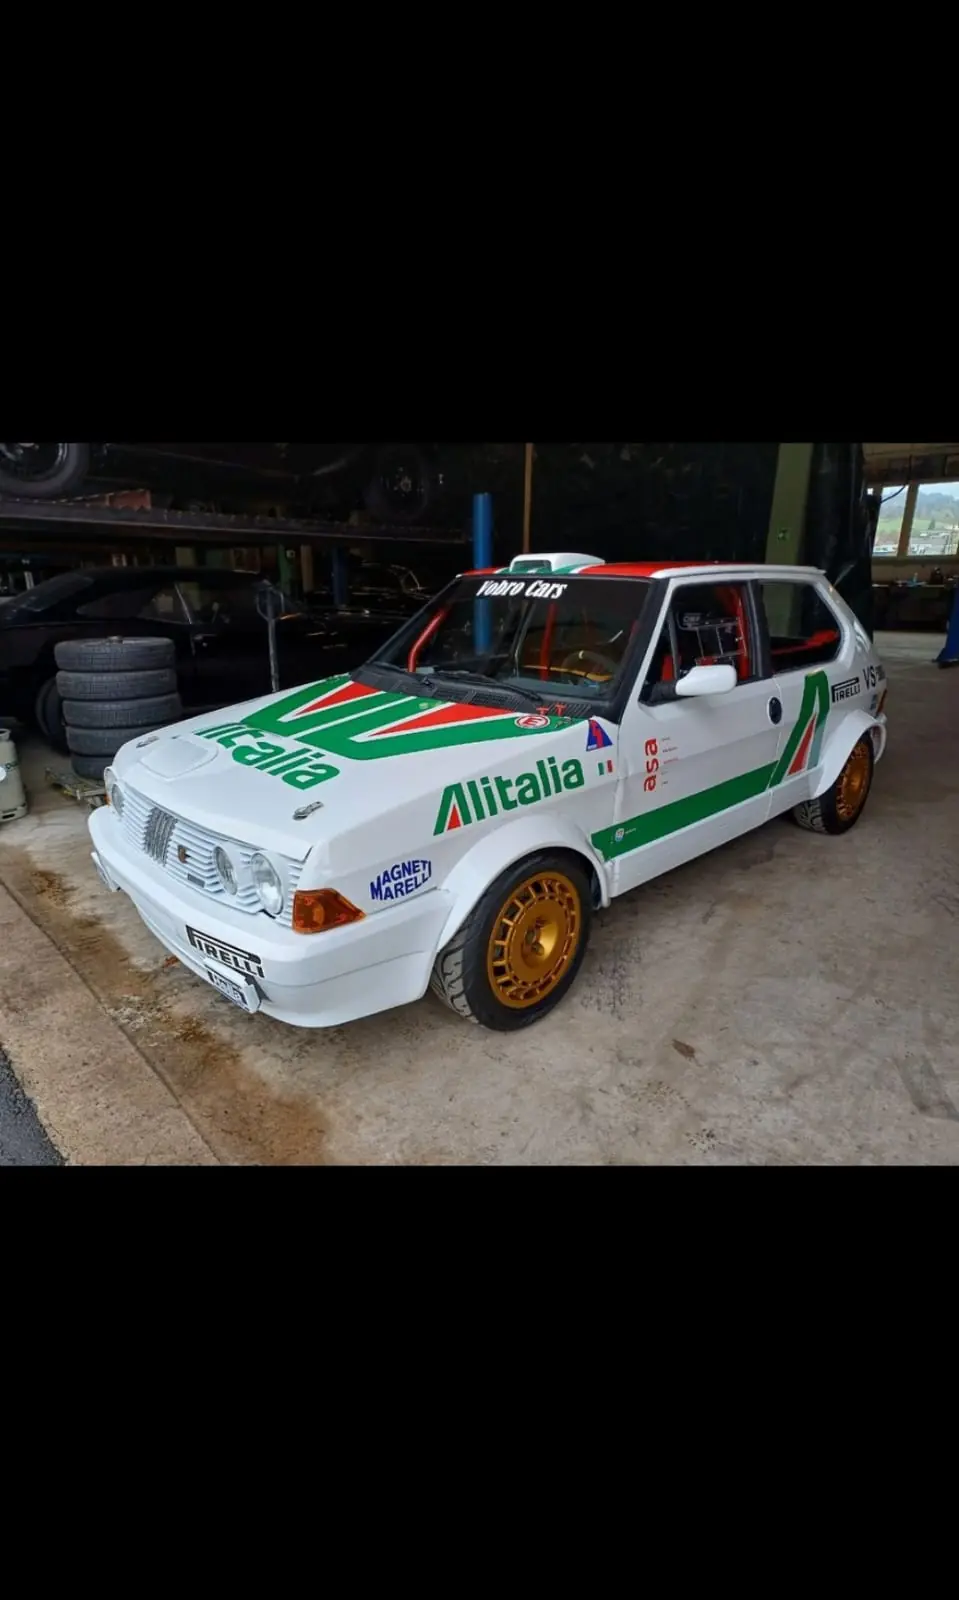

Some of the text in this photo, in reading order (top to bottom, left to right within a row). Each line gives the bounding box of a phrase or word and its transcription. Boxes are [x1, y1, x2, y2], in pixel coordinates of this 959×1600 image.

[524, 580, 568, 599] Cars
[831, 676, 861, 703] PIRELLI
[643, 737, 659, 793] asa
[433, 756, 585, 836] Alitalia
[370, 860, 432, 897] MAGNETI
[370, 864, 432, 901] MARELLI
[185, 924, 265, 979] PIRELLI
